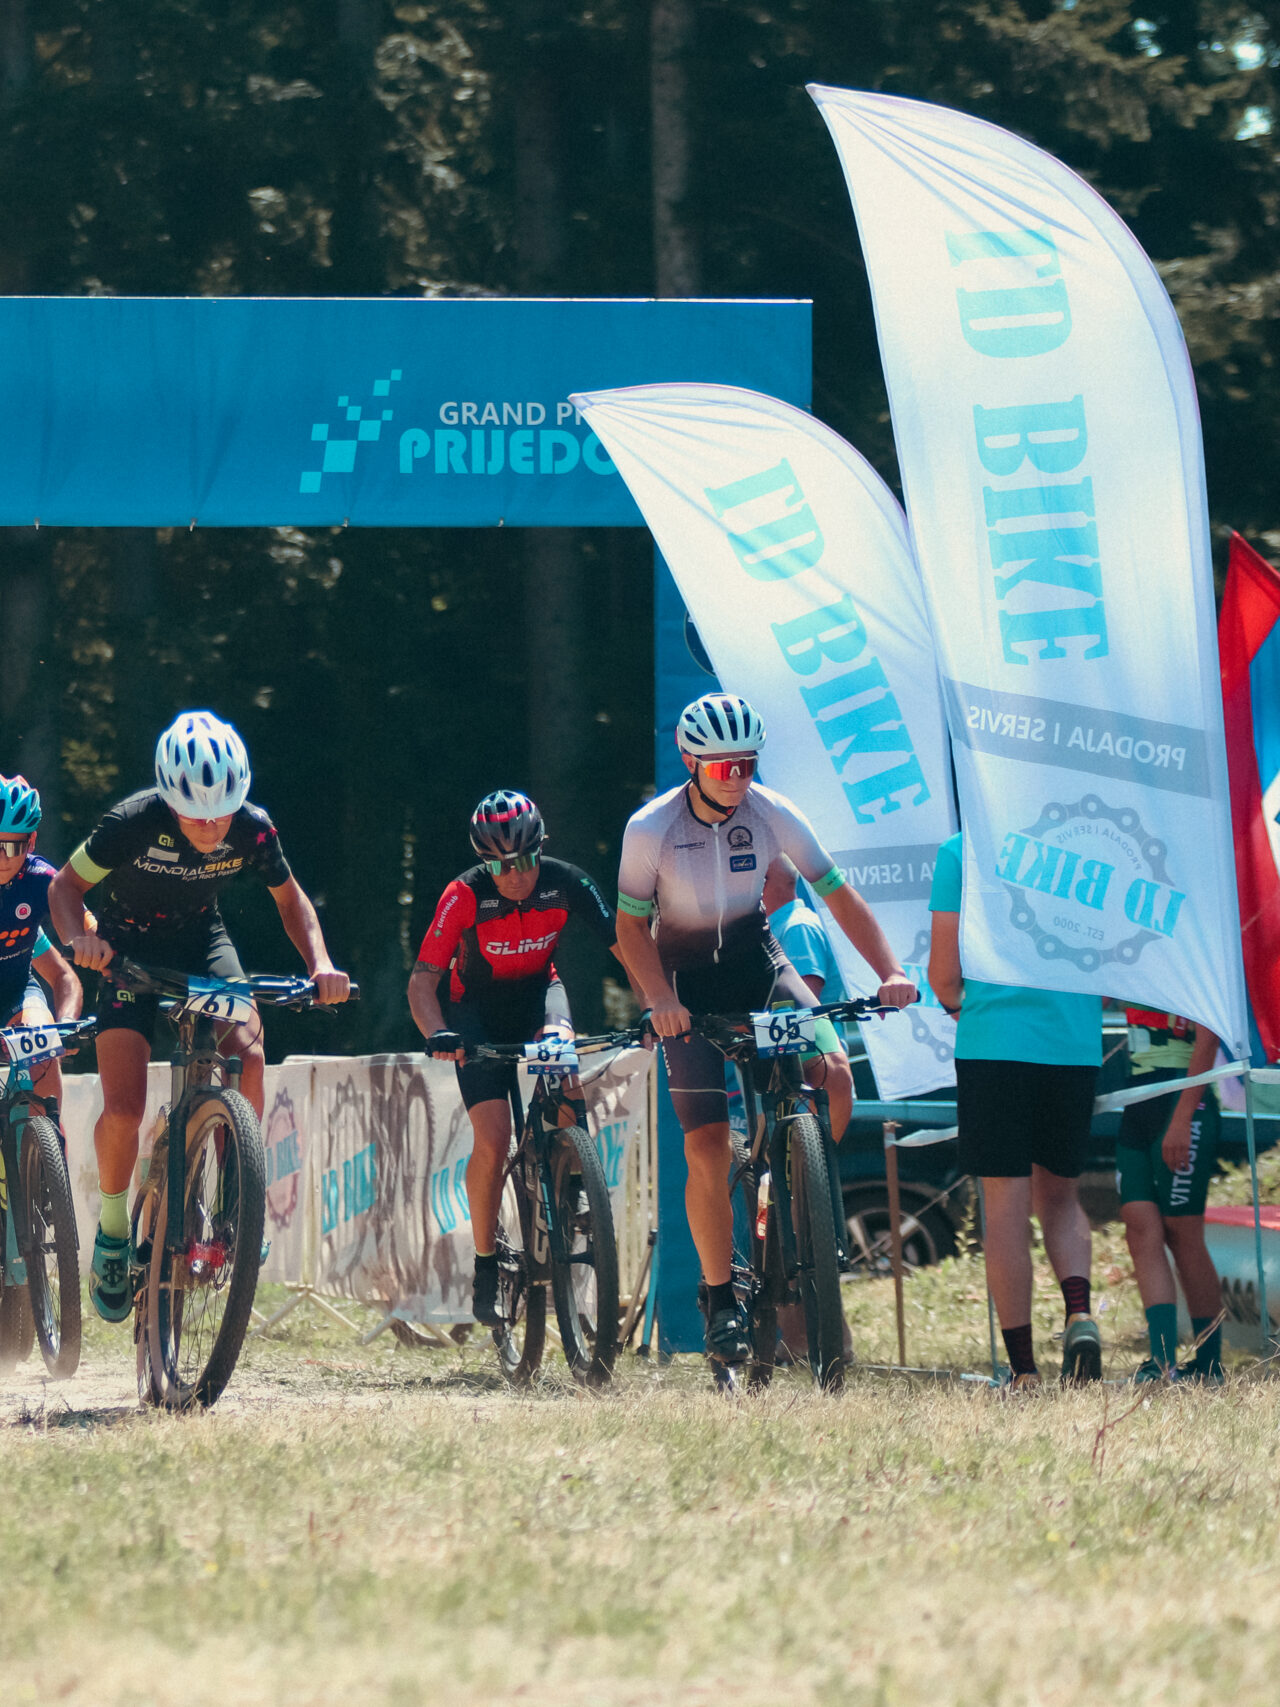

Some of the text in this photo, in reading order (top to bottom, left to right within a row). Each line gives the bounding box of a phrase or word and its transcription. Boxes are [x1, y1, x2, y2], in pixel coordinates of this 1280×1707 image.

[439, 401, 584, 426] GRAND PR
[399, 428, 621, 475] PRIJEDO
[203, 994, 235, 1018] 61
[769, 1014, 801, 1042] 65
[20, 1033, 48, 1055] 66
